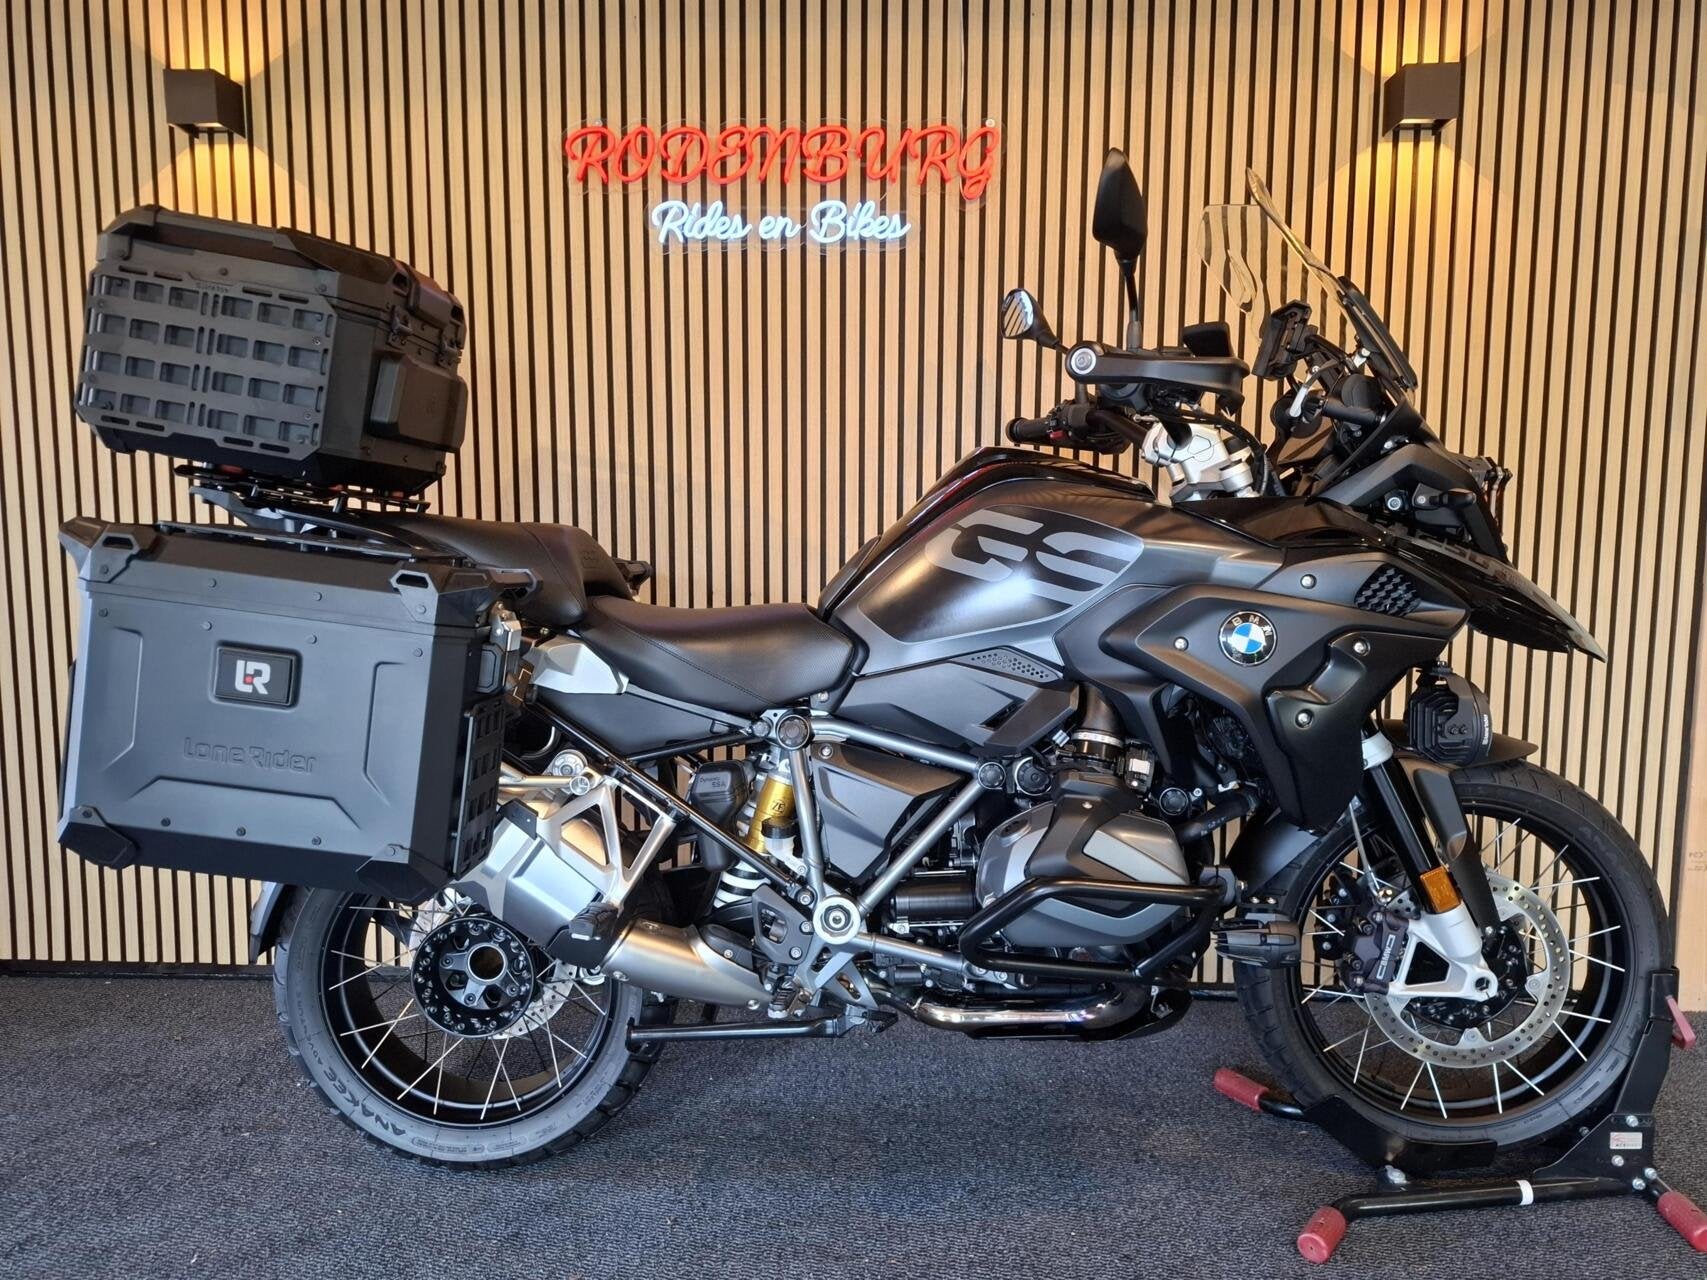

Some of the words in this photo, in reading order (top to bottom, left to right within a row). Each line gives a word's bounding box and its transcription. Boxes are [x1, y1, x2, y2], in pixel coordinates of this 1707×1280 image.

[565, 125, 999, 200] RODENBURG
[652, 200, 752, 243] Rides
[758, 211, 802, 239] en
[810, 200, 912, 243] Bikes
[1232, 614, 1273, 636] BMW
[235, 660, 271, 695] LR
[1380, 946, 1393, 967] BMW
[323, 1066, 406, 1136] ANAKEE
